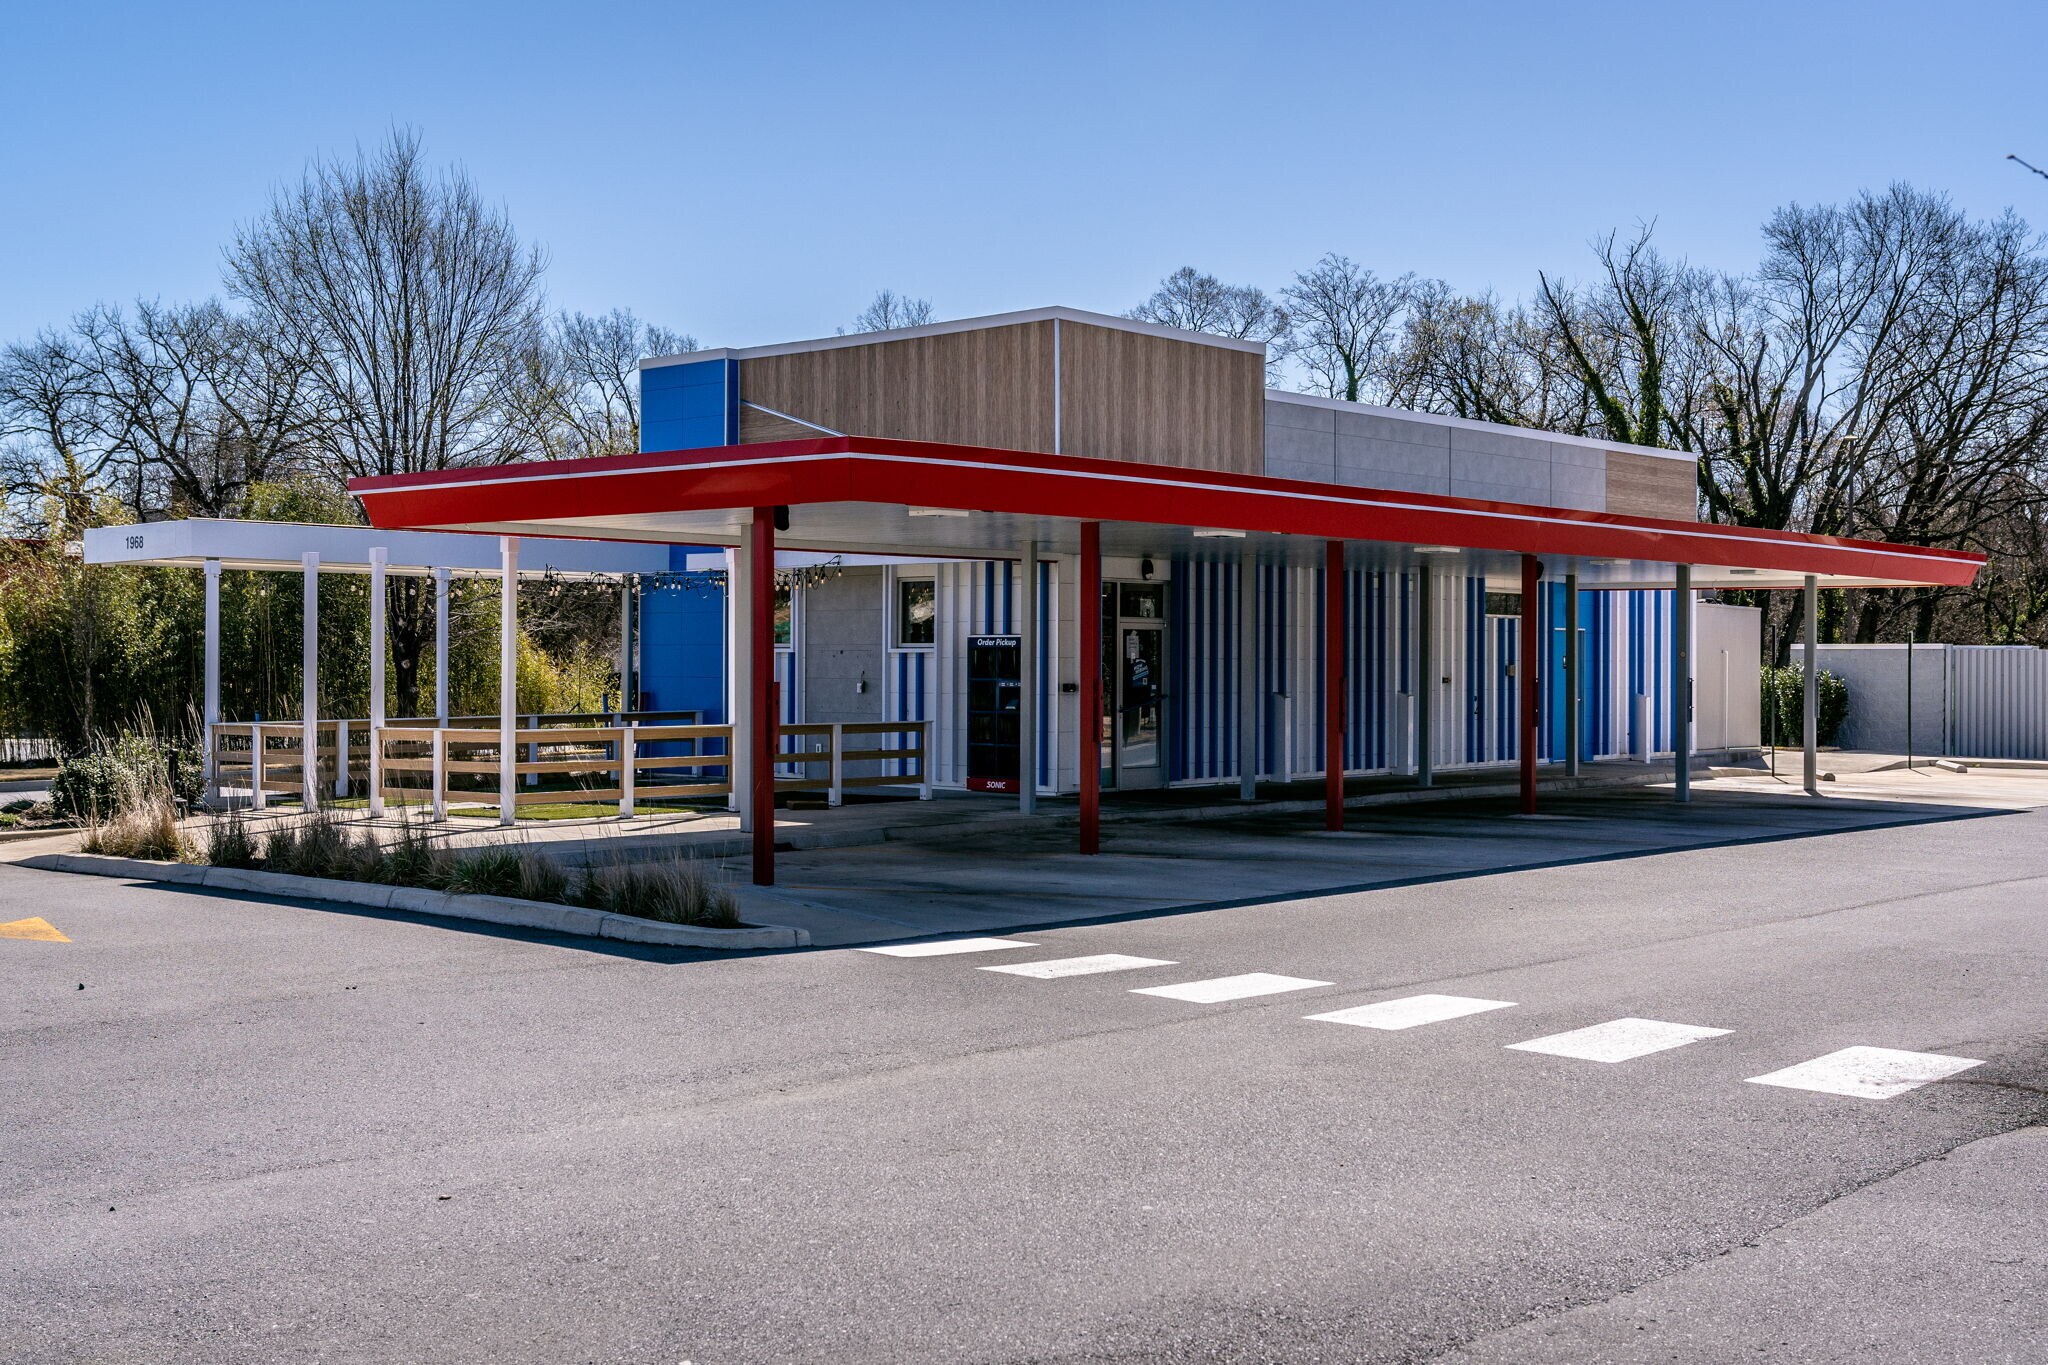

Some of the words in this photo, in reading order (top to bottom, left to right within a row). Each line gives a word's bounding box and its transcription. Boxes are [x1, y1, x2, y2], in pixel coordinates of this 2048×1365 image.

[126, 535, 144, 549] 1968
[977, 638, 995, 646] Order
[995, 638, 1017, 647] Pickup
[986, 781, 1006, 789] SONIC
